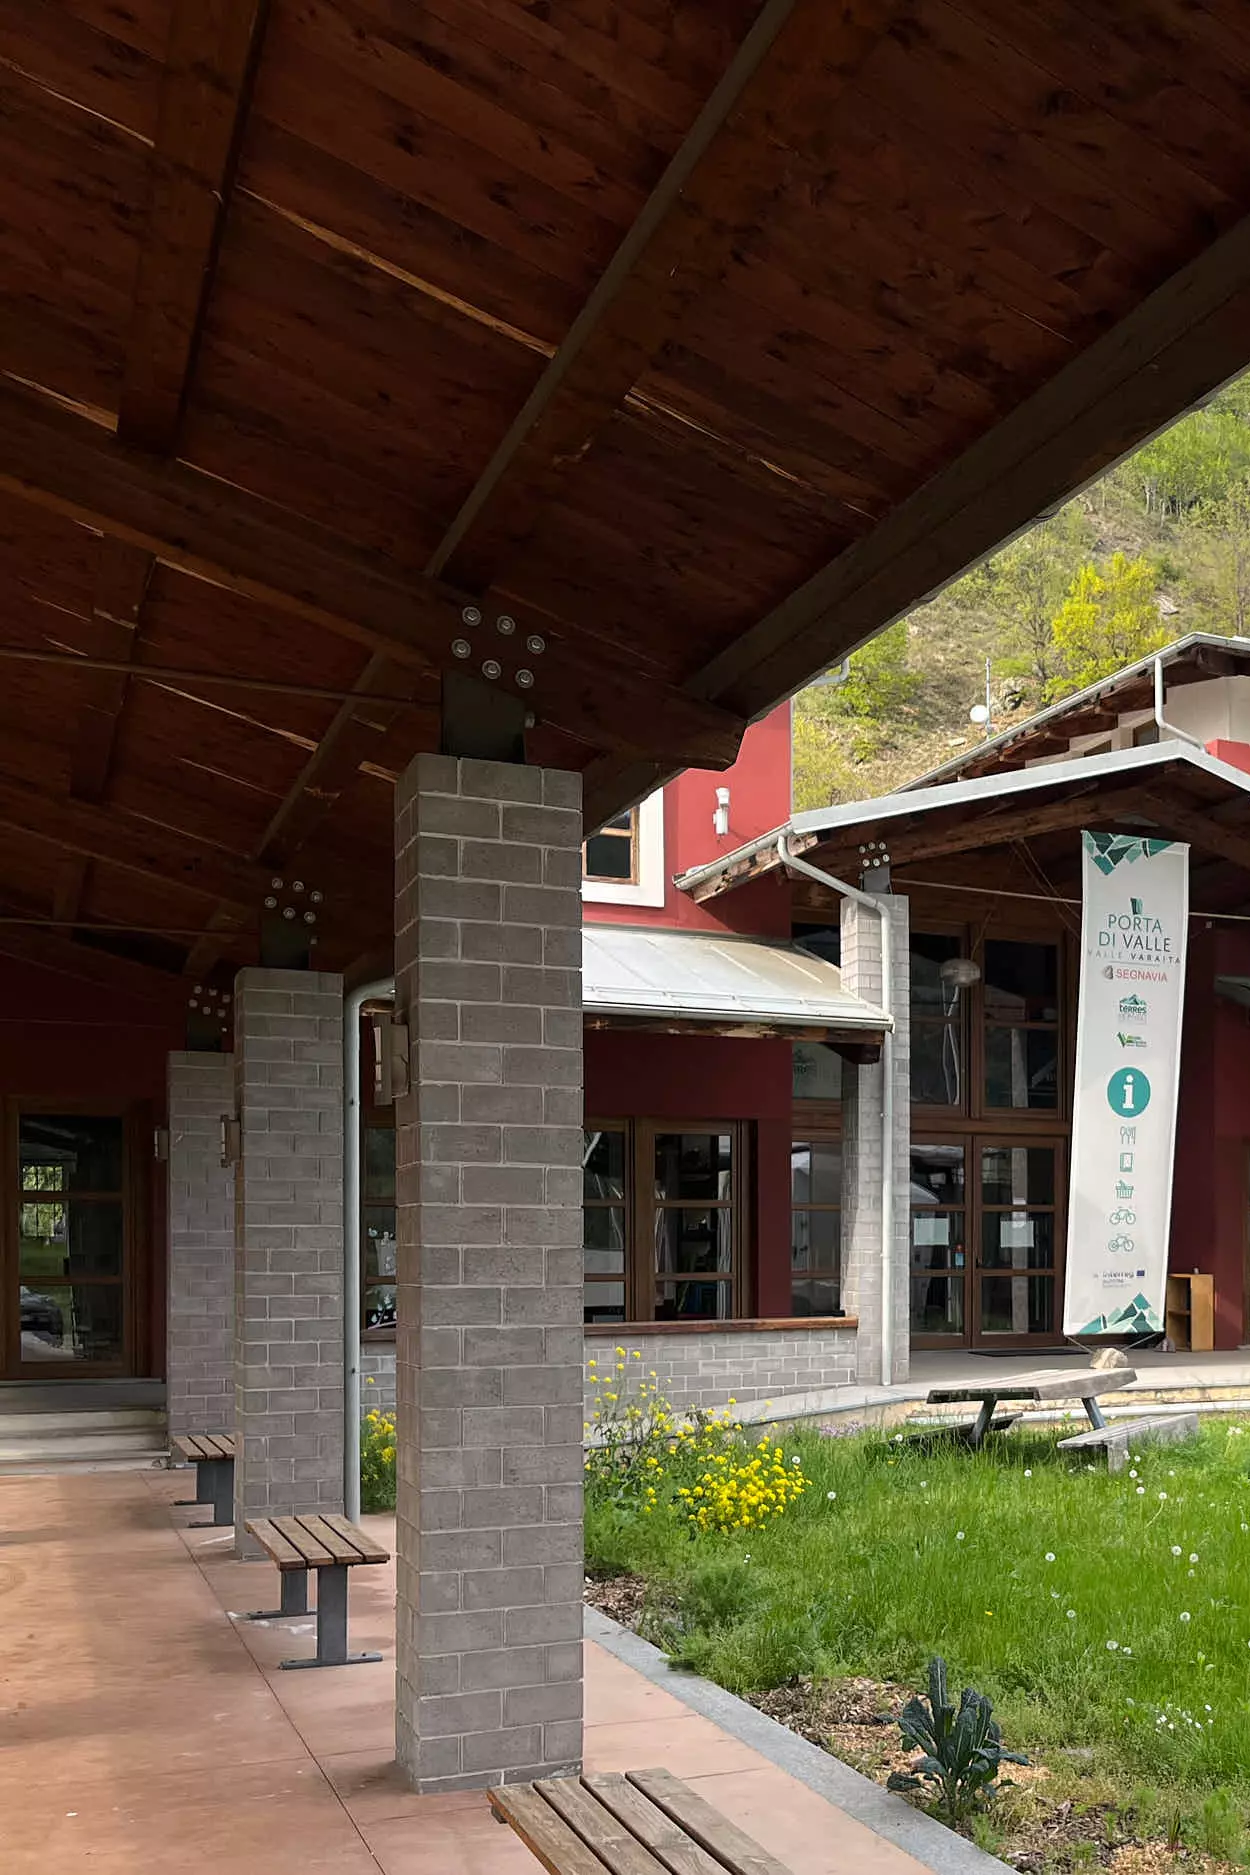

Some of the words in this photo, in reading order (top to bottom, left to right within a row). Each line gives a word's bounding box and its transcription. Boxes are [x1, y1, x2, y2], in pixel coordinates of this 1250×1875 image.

[1108, 913, 1162, 935] PORTA
[1098, 931, 1116, 948] DI
[1122, 934, 1171, 953] VALLE
[1130, 952, 1181, 964] VARAITA
[1115, 967, 1168, 983] SEGNAVIA
